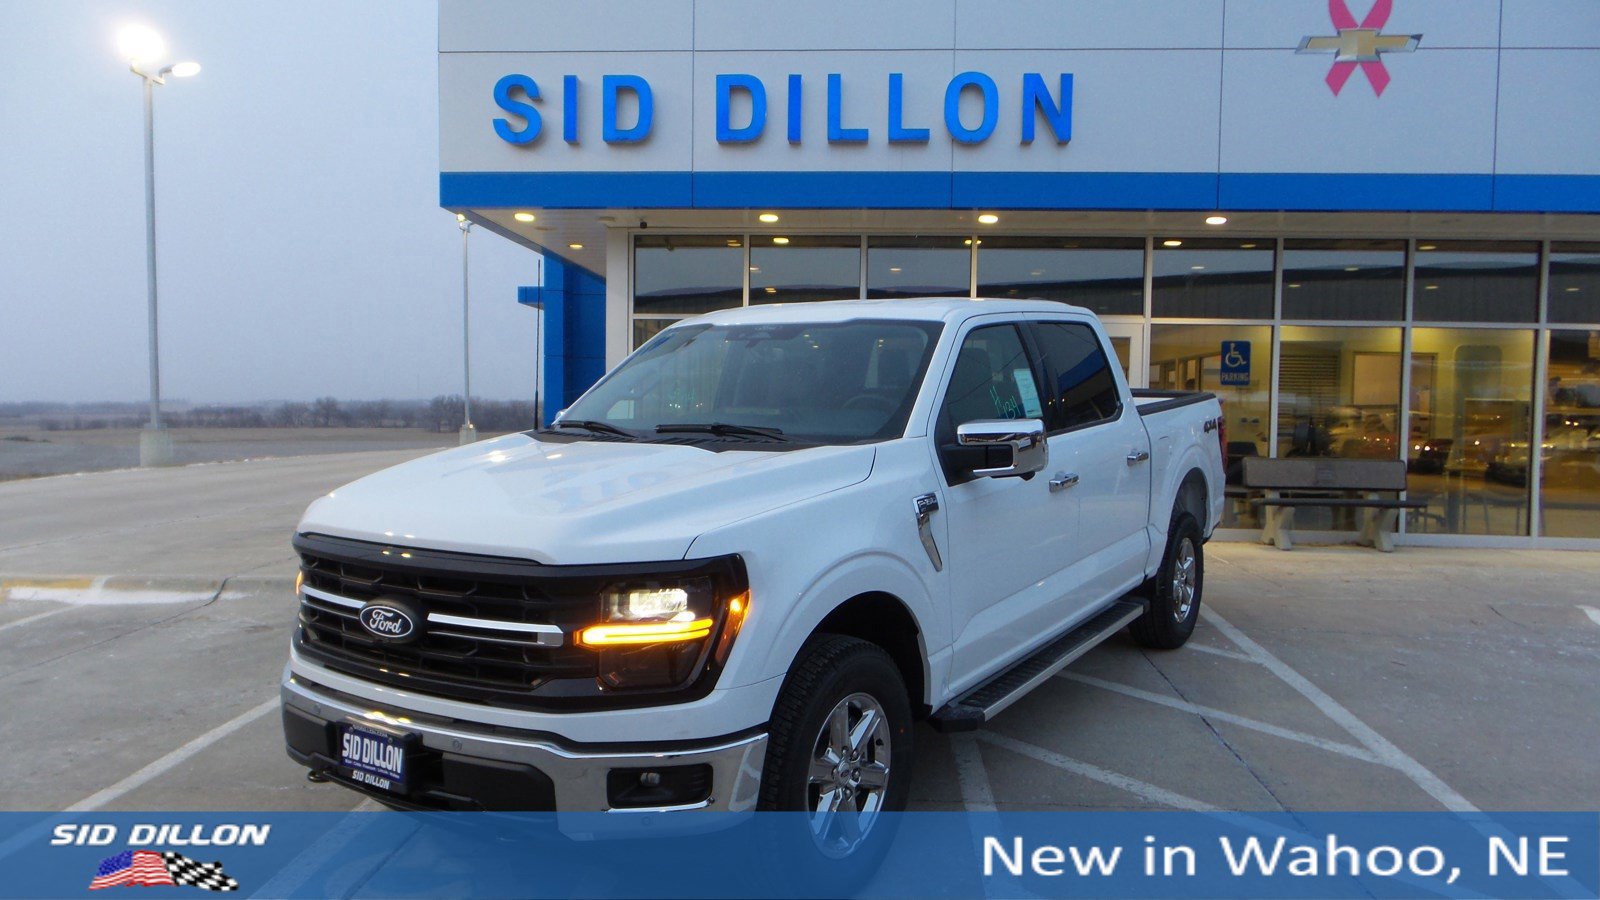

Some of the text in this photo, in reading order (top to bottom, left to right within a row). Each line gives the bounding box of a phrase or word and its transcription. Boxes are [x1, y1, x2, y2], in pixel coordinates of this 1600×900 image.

[492, 71, 1074, 145] SID DILLON
[1221, 372, 1249, 382] PARKING
[369, 609, 402, 633] Ford
[342, 732, 361, 760] SID
[362, 738, 403, 774] DILLON
[352, 770, 390, 790] SID DILLON
